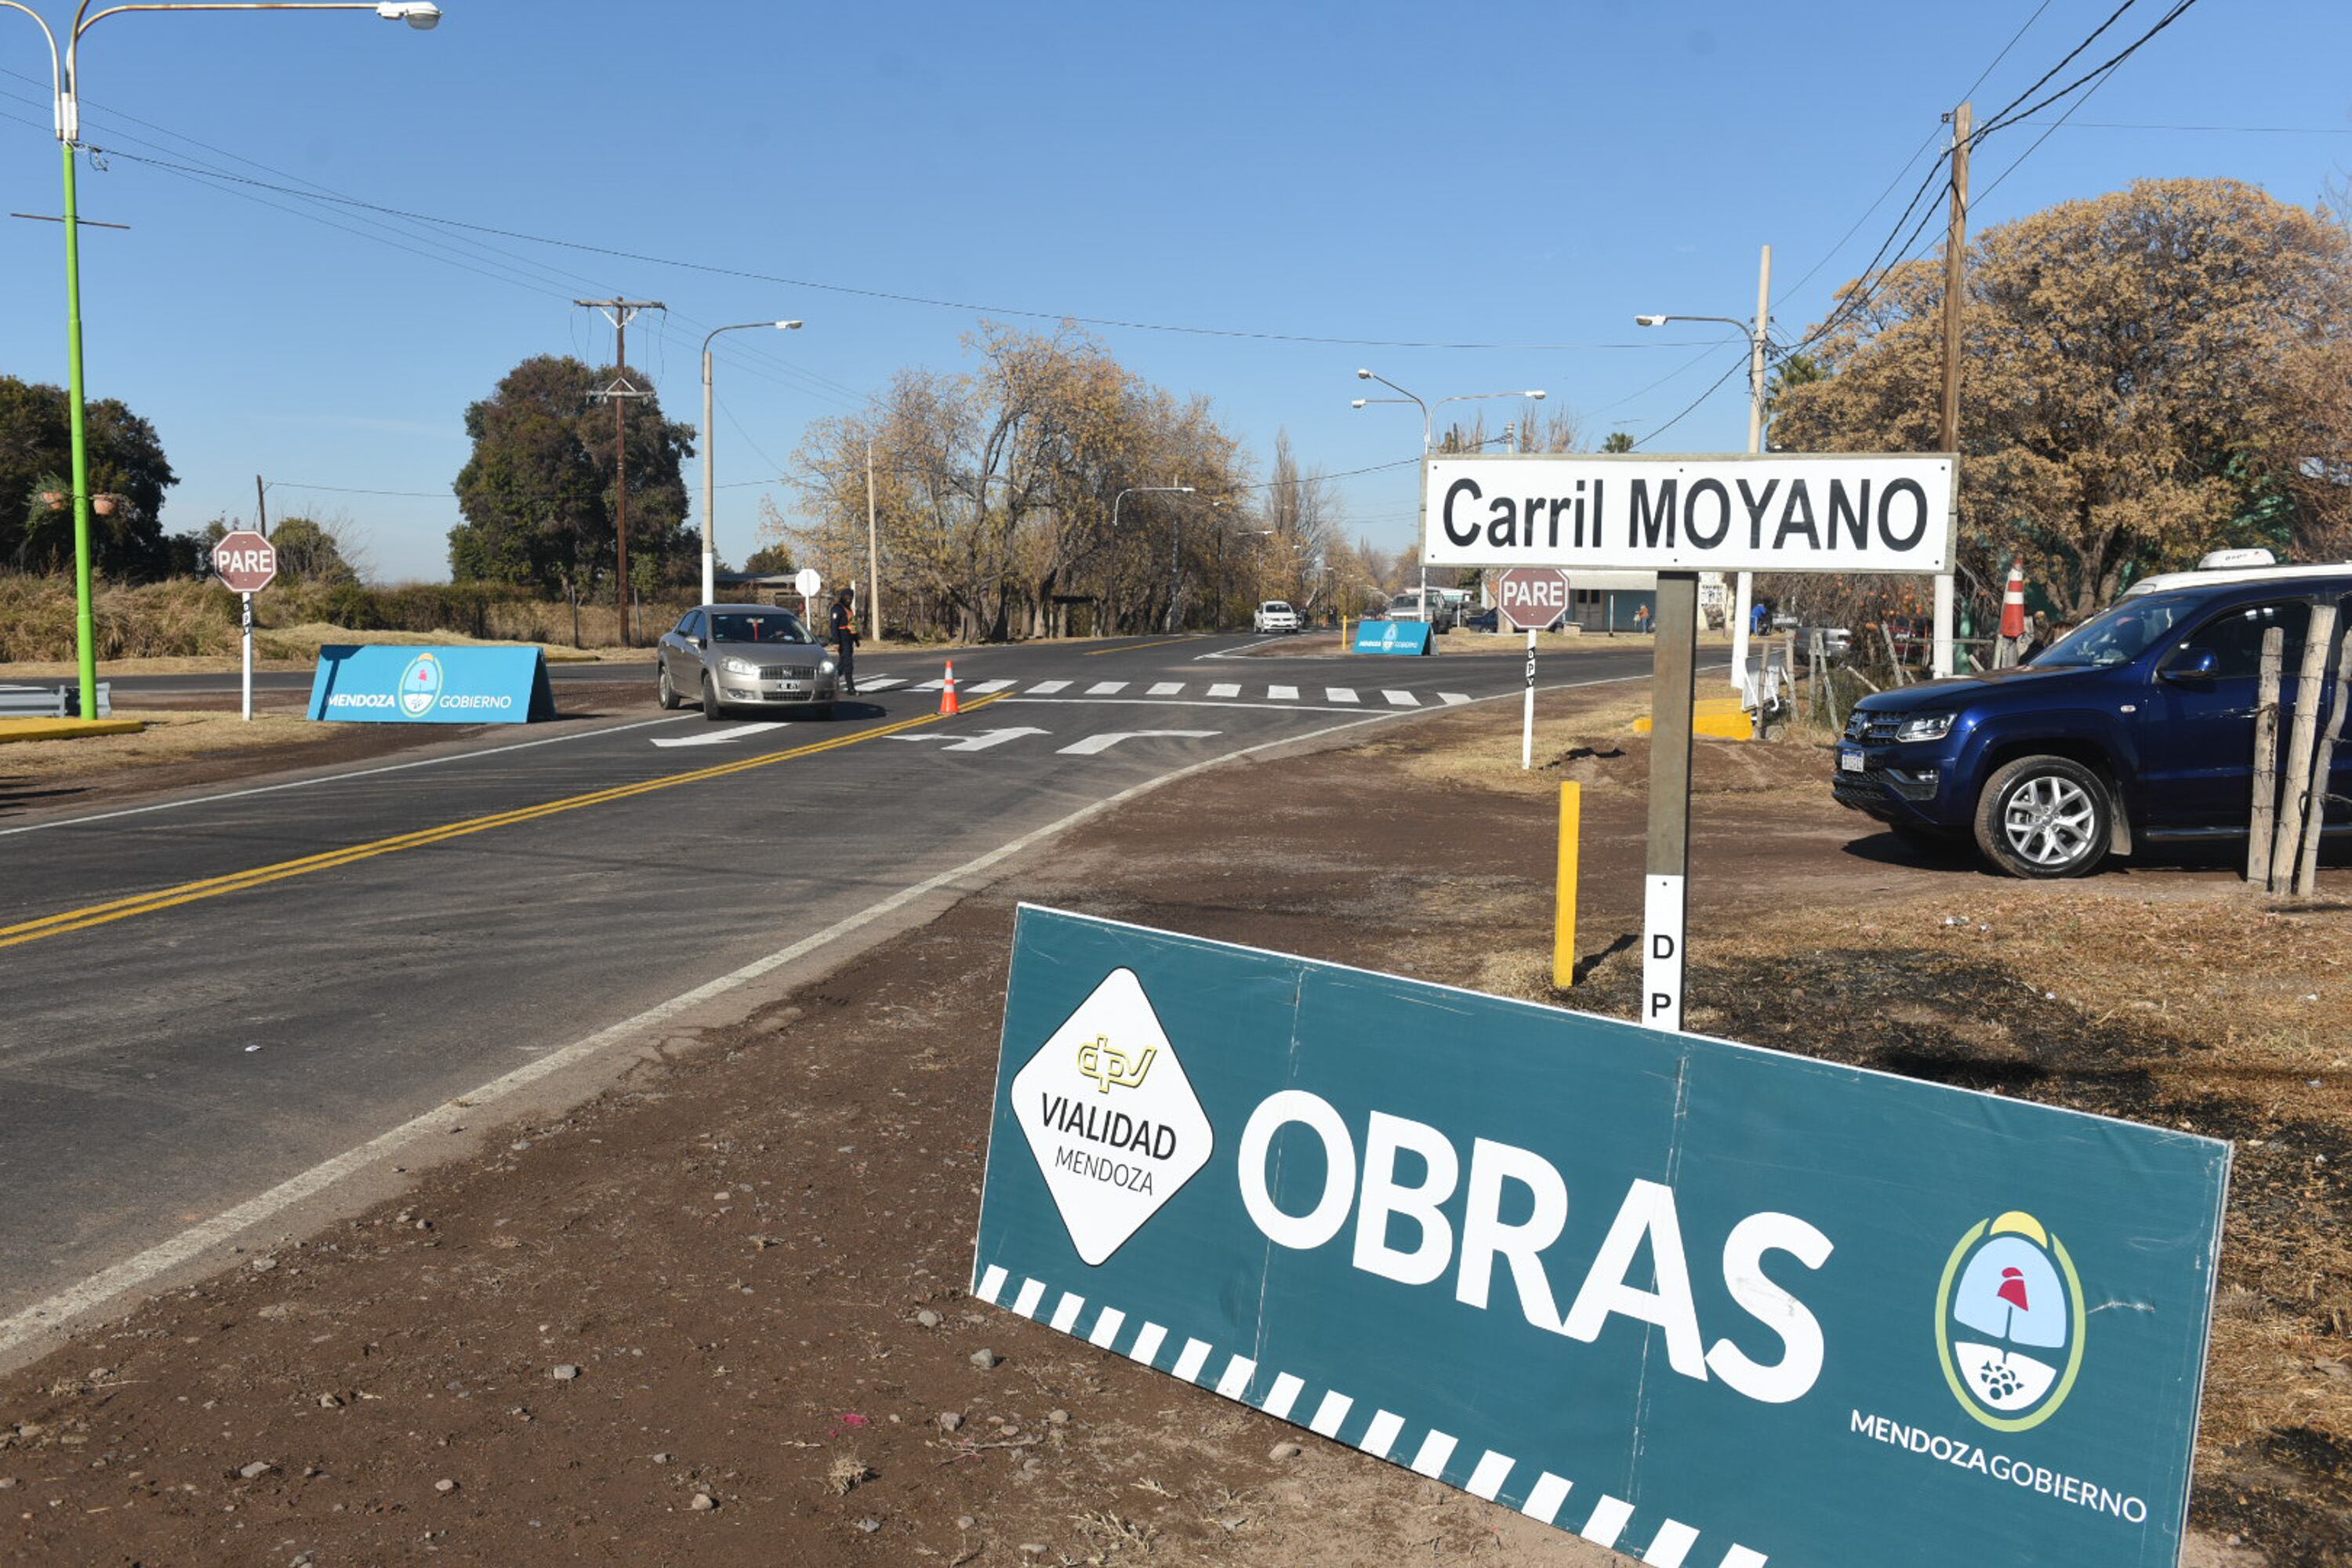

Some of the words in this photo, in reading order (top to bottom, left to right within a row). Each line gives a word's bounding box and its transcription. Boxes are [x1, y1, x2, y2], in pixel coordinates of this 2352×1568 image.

[1443, 477, 1603, 548] Carril
[1628, 477, 1928, 552] MOYANO
[218, 550, 273, 573] PARE
[1503, 581, 1563, 607] PARE
[328, 695, 396, 709] MENDOZA
[439, 695, 512, 710] GOBIERNO
[1041, 1091, 1177, 1160] VIALIDAD
[1054, 1145, 1153, 1196] MENDOZA
[1237, 1089, 1835, 1404] OBRAS
